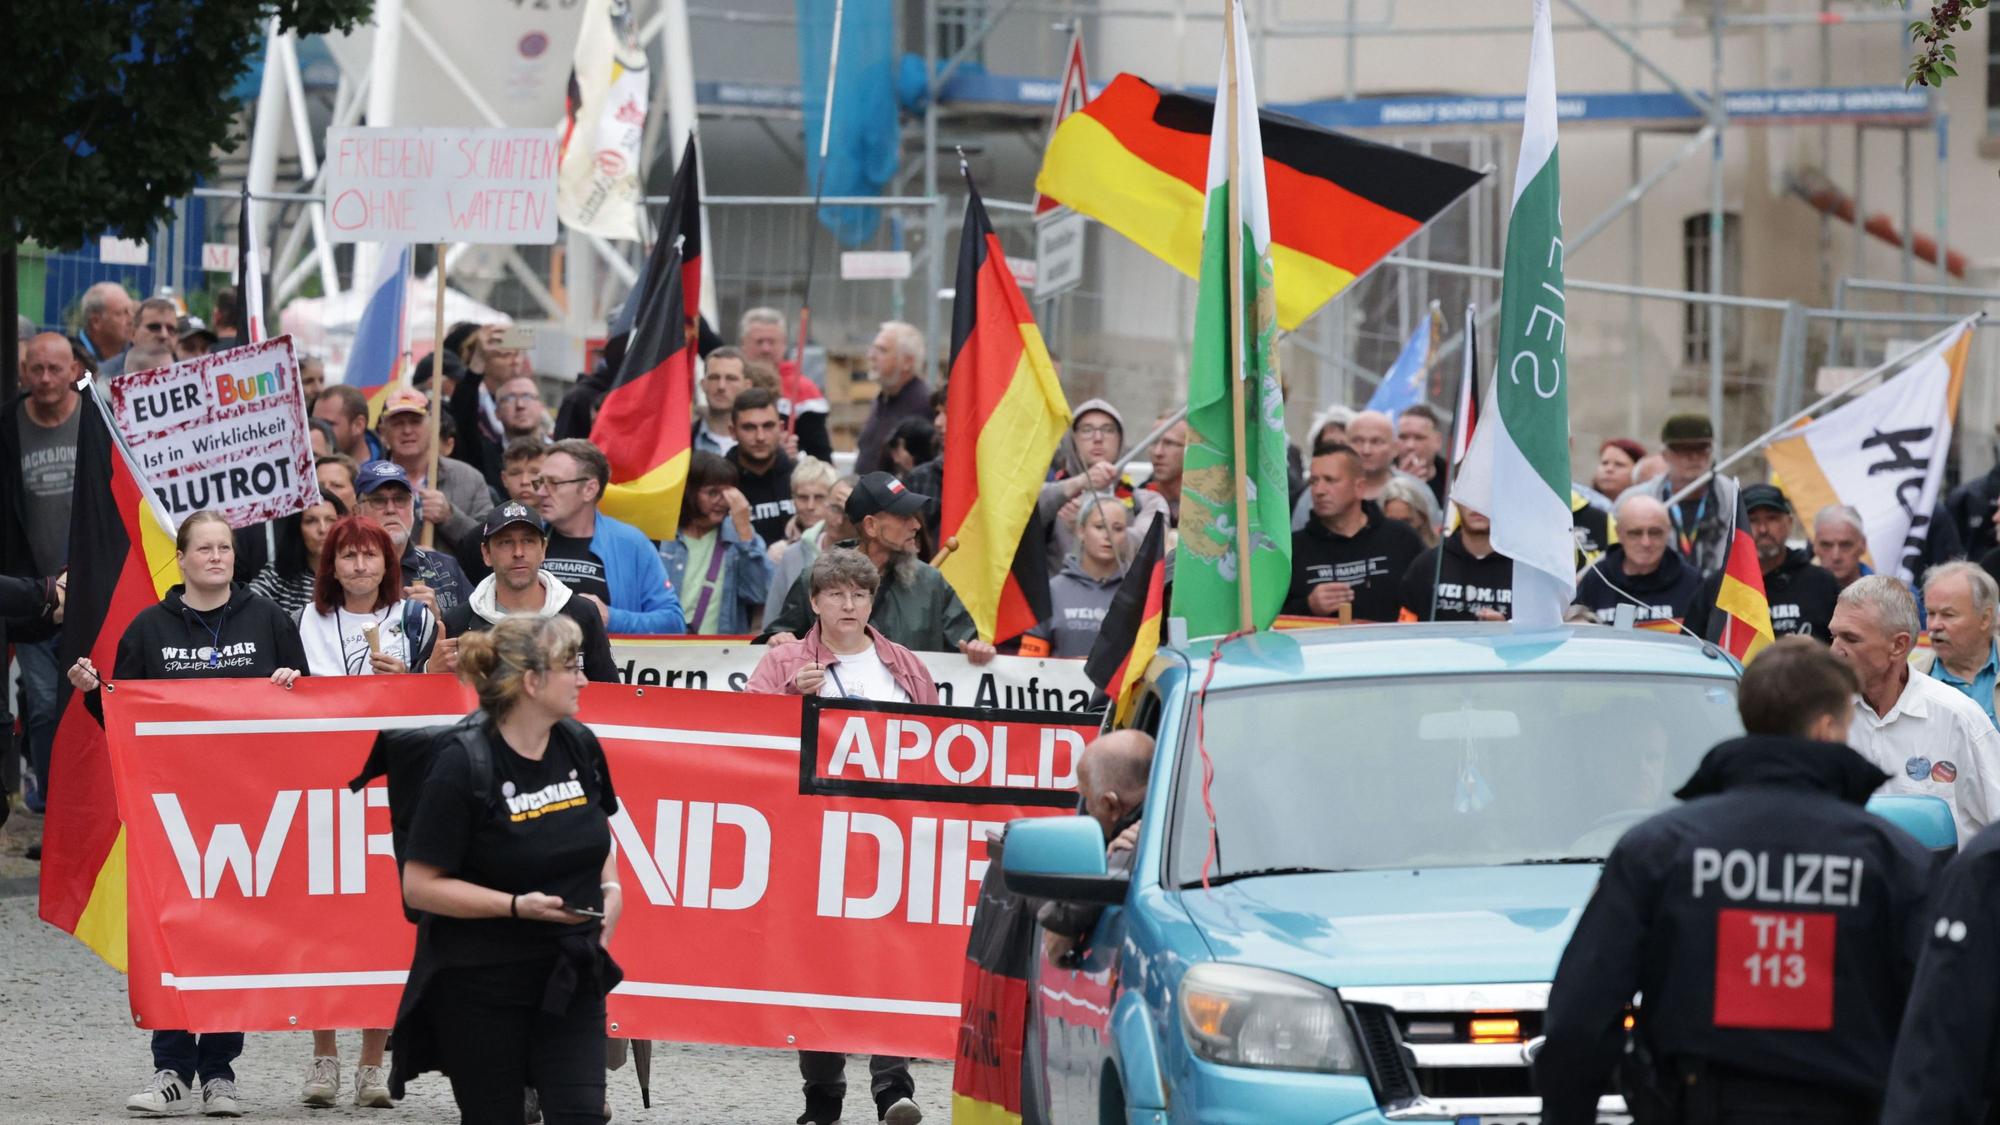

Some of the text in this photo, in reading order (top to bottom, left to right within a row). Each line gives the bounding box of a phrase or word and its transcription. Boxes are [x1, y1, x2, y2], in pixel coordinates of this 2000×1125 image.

[339, 136, 560, 180] FRIEDEN SCHAFFEN
[333, 188, 418, 231] OHNE
[446, 188, 549, 231] WAFFEN
[133, 362, 287, 423] EUER Bunt
[143, 416, 287, 469] Ist in Wirklichkeit
[616, 660, 708, 689] dern
[973, 673, 1090, 713] Aufna
[827, 716, 1086, 790] APOLD
[608, 797, 772, 910] ND
[1692, 848, 1864, 906] POLIZEI
[1750, 916, 1805, 950] TH
[1743, 953, 1807, 988] 113
